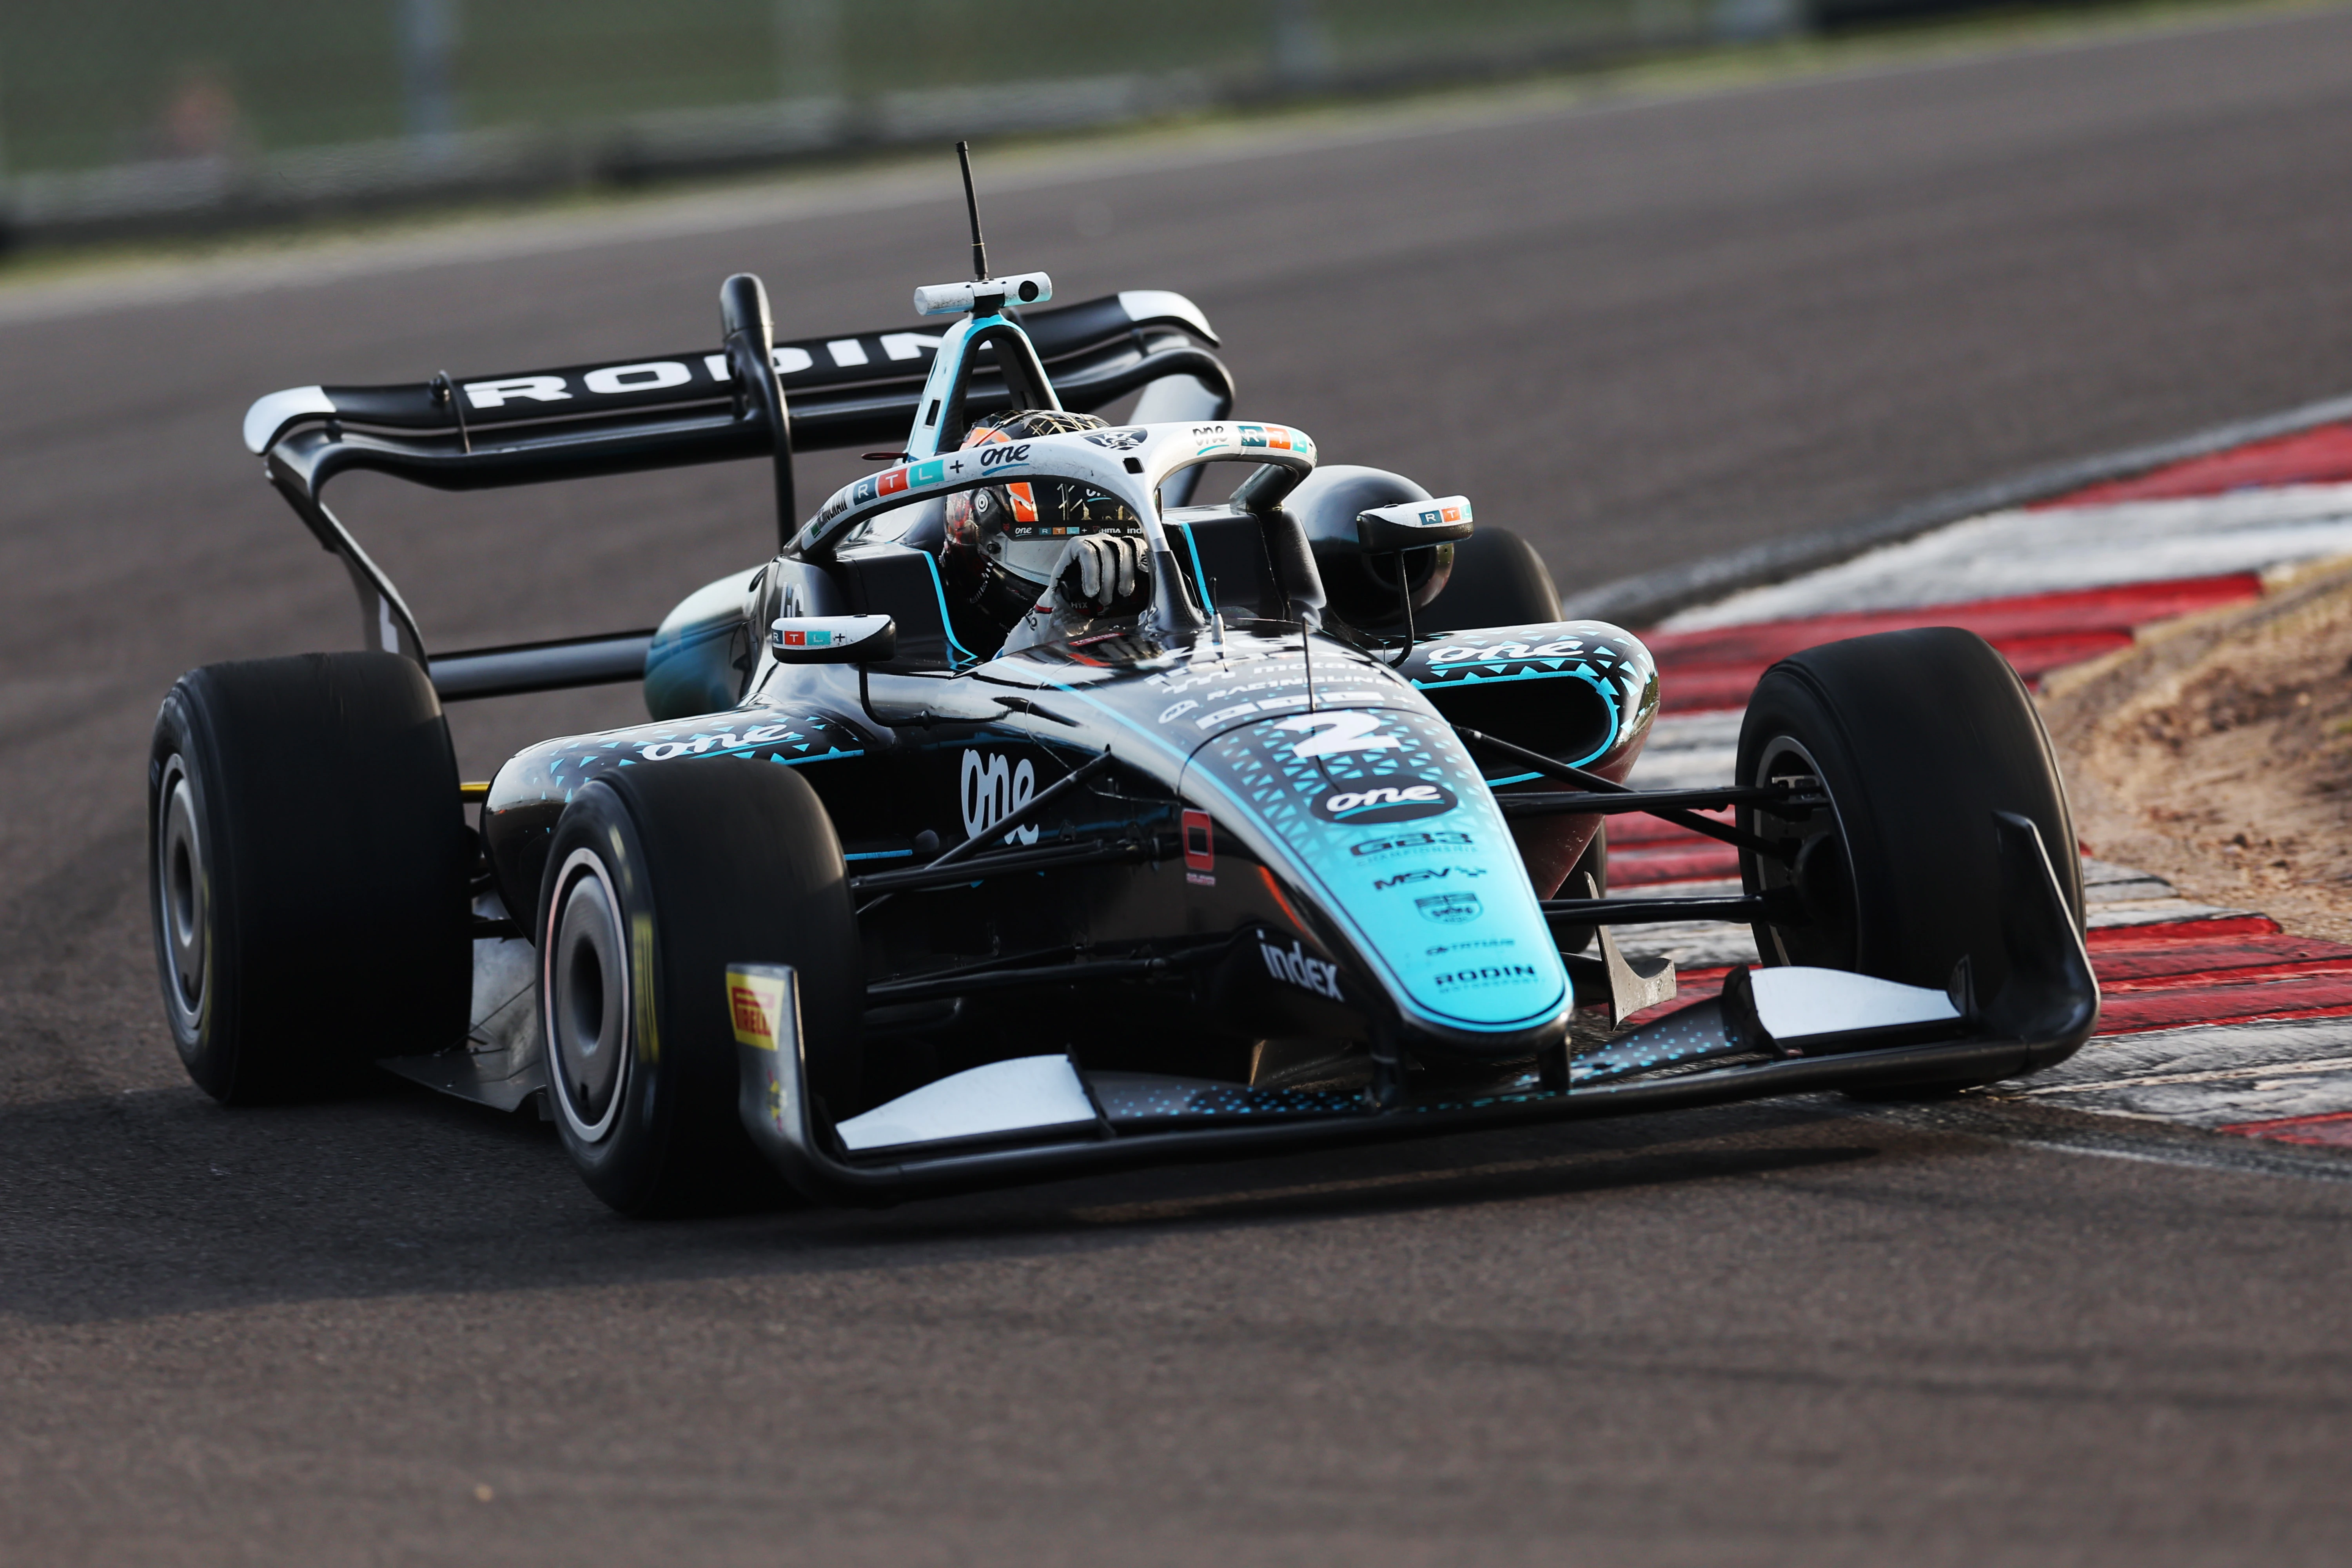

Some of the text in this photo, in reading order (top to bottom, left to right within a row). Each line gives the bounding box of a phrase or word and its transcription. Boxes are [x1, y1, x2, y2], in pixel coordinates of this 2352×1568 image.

[1192, 426, 1228, 446] one
[980, 444, 1029, 466] one
[1428, 640, 1584, 661] one
[642, 724, 796, 761] one
[1273, 711, 1401, 758] 2
[961, 748, 1039, 845] one
[1326, 785, 1441, 813] one
[1349, 831, 1474, 857] GB3
[1374, 867, 1450, 891] MSV
[1434, 964, 1536, 986] RODIN
[731, 986, 775, 1037] PIRELLI
